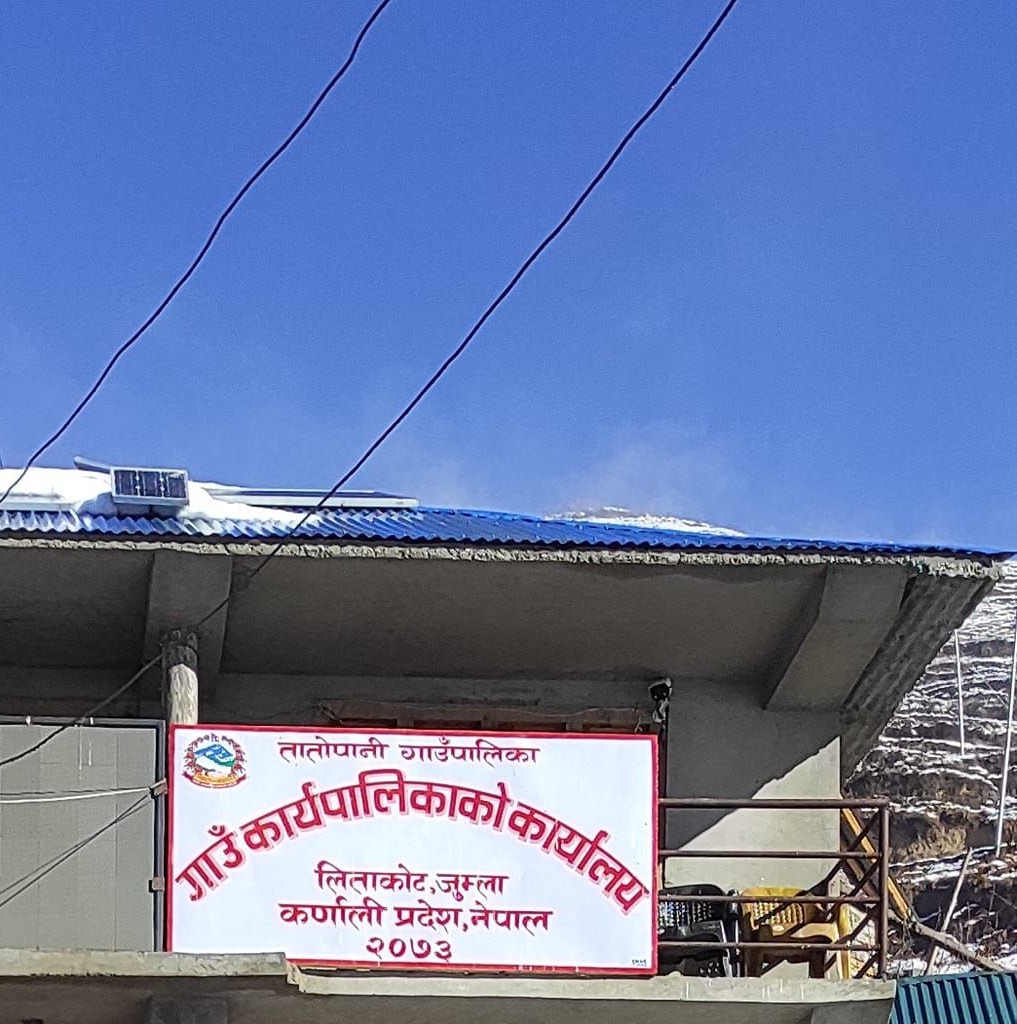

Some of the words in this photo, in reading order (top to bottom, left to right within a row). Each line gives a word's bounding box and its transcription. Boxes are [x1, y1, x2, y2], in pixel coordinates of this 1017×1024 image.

[278, 736, 389, 763] तातोपानी
[399, 737, 540, 768] गाउँपालिका
[175, 825, 243, 901] गाउँ
[244, 768, 512, 852] कार्यपालिकाको
[507, 801, 651, 916] कार्यालय
[279, 896, 387, 930] कर्णाली
[366, 937, 452, 962] २०७३
